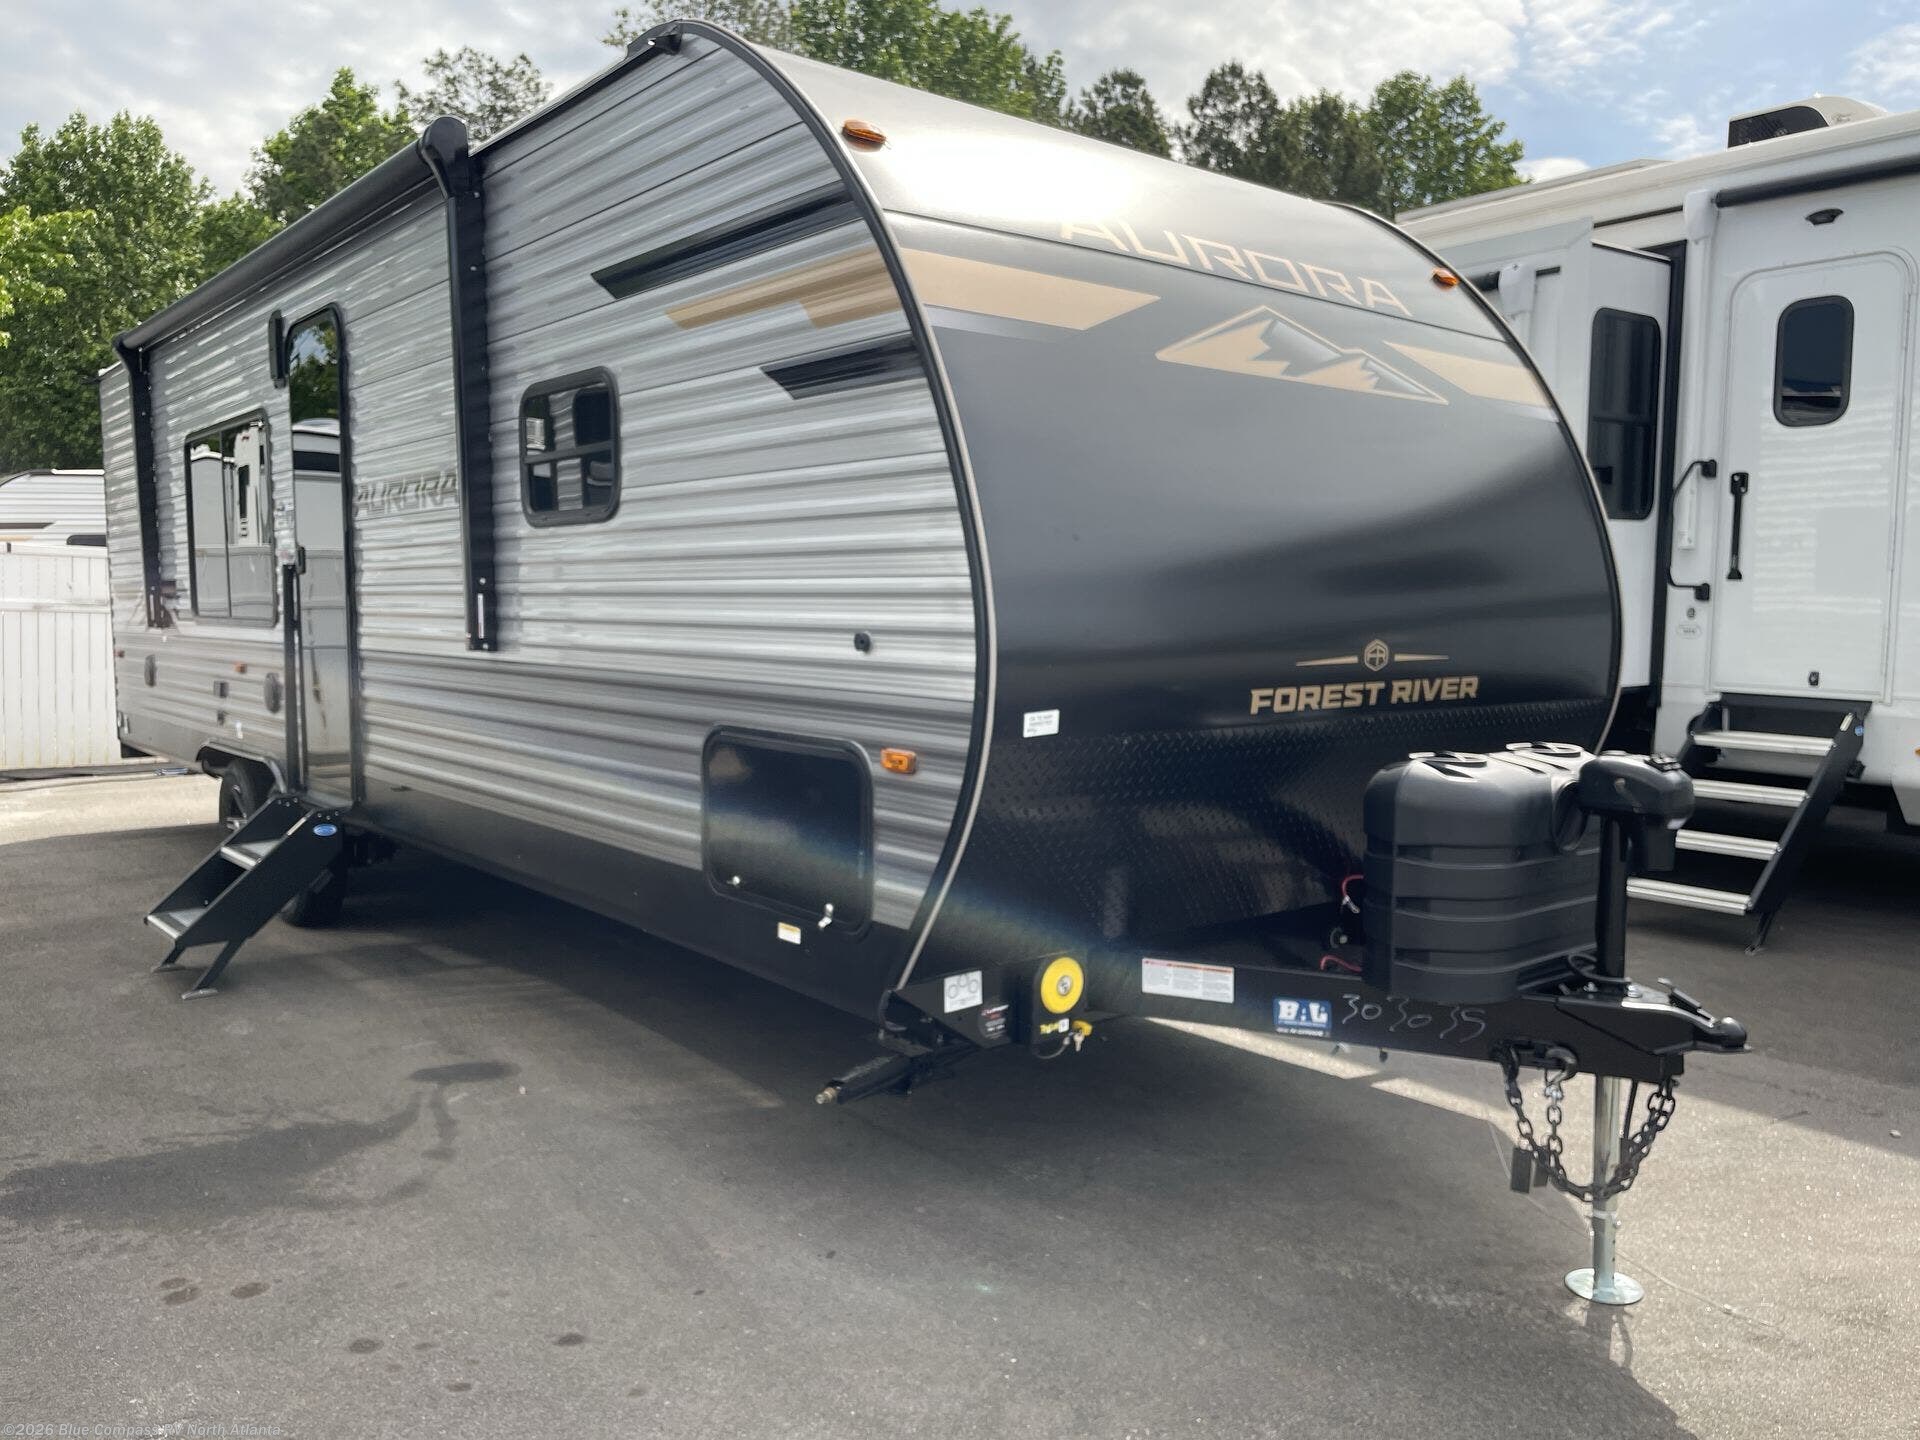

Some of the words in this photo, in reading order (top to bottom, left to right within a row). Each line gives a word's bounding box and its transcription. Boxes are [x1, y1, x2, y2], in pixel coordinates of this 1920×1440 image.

[1059, 219, 1414, 318] AURORA
[356, 473, 458, 513] AURORA
[1250, 680, 1386, 716] FOREST
[1390, 675, 1479, 705] RIVER
